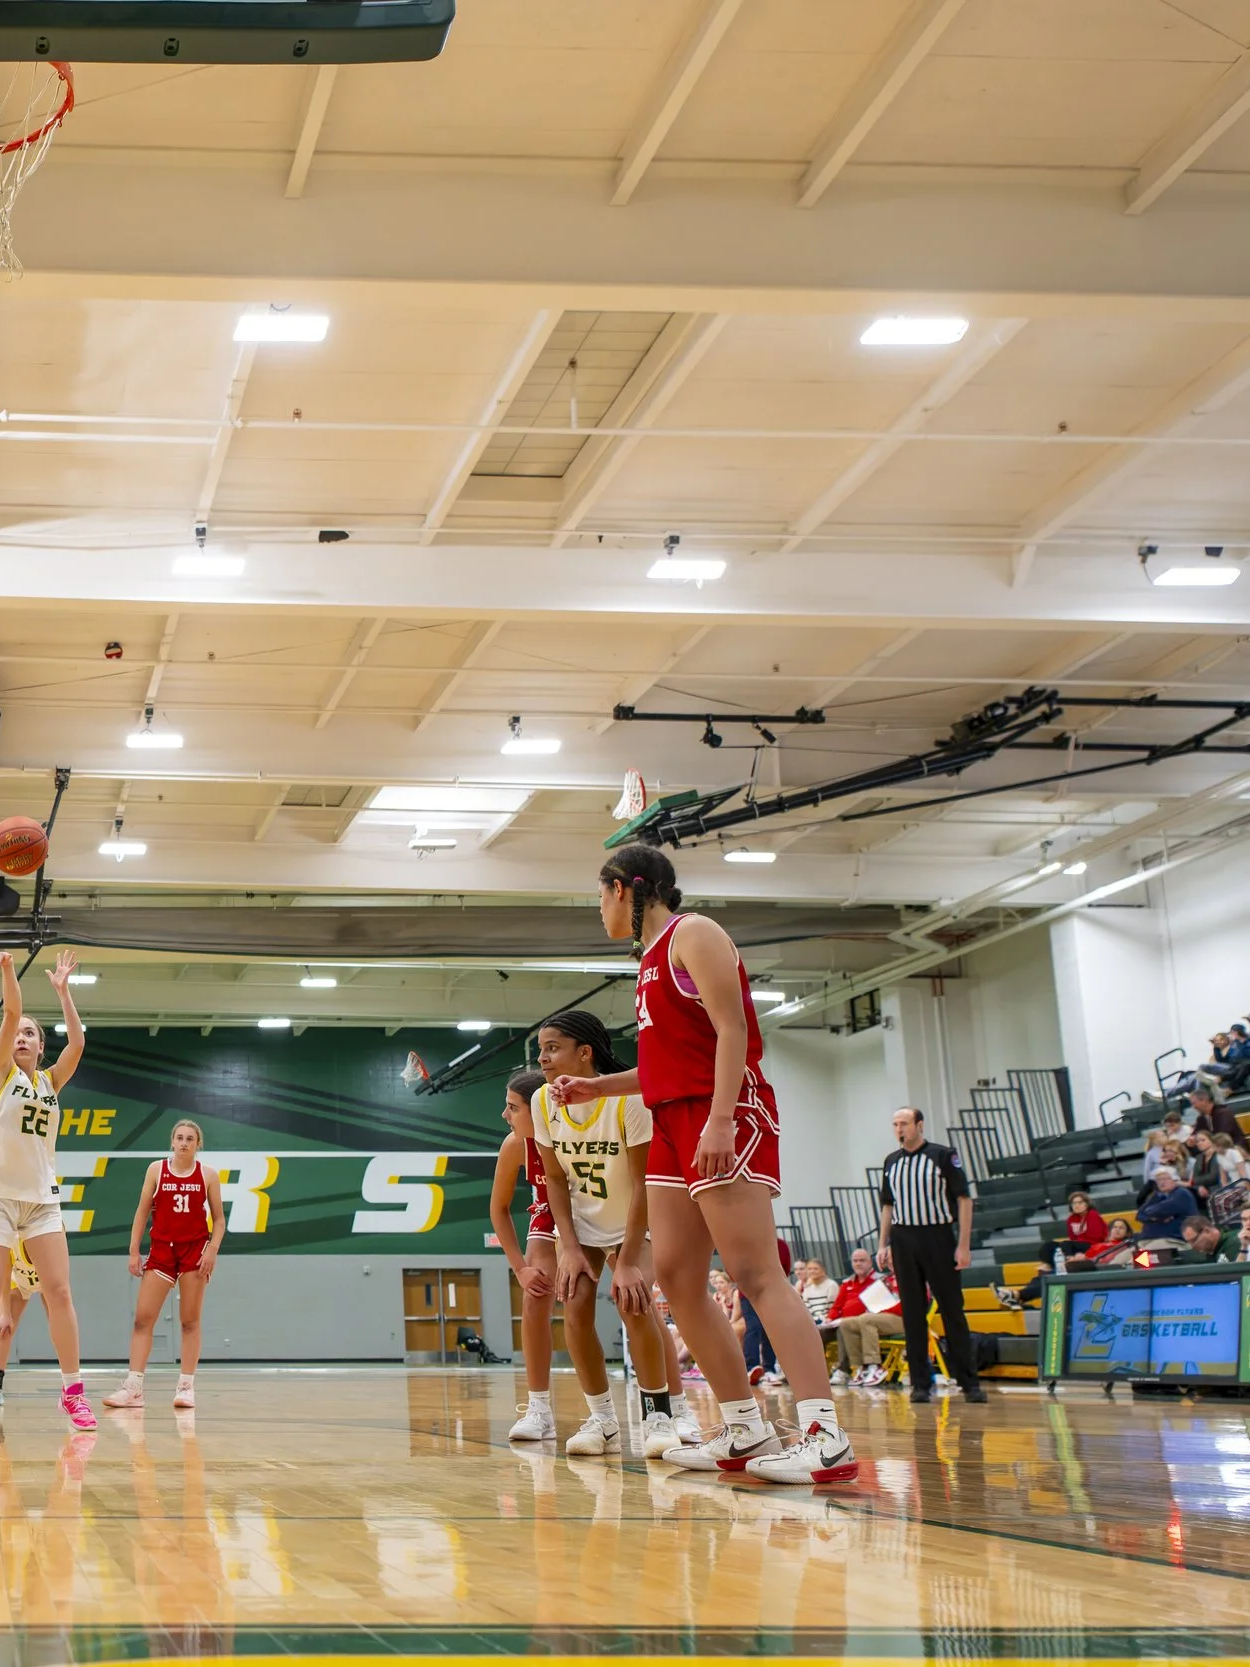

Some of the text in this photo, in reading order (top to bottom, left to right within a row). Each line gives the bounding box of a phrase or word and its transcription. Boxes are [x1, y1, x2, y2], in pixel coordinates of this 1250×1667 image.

[21, 1105, 50, 1137] 22
[59, 1109, 117, 1136] HE
[552, 1141, 619, 1155] FLYERS
[162, 1183, 201, 1192] COR JESU
[572, 1162, 608, 1199] 55
[173, 1194, 190, 1213] 31
[1122, 1321, 1218, 1338] BASKETBALL
